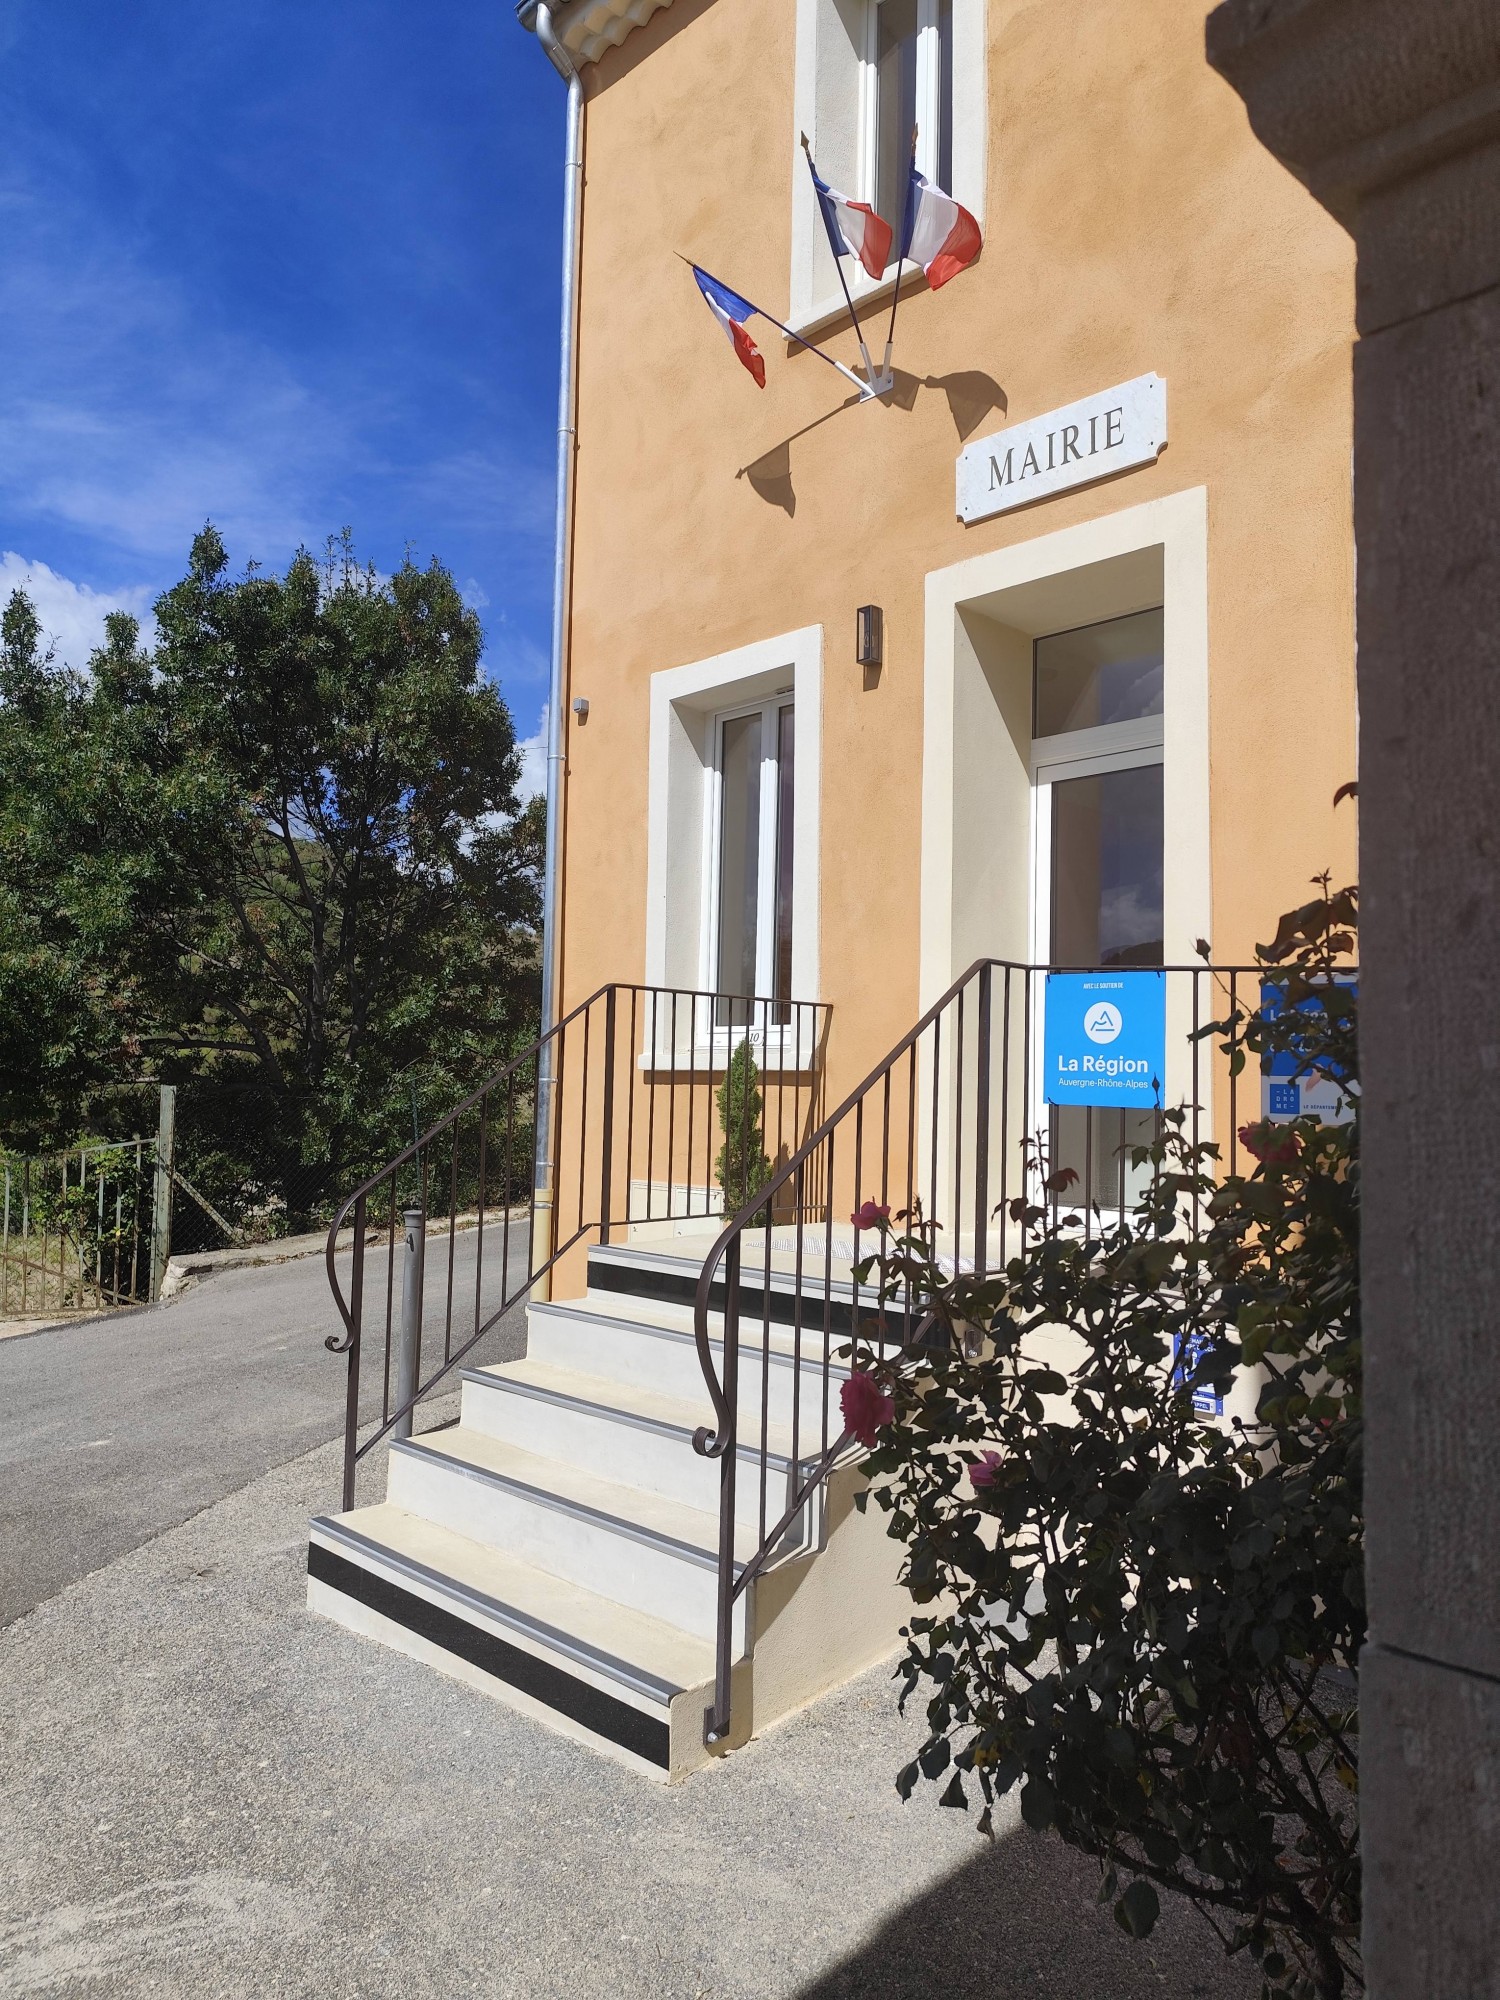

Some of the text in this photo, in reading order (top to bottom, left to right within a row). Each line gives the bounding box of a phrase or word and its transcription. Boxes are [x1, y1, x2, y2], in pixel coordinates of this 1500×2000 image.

[988, 407, 1125, 491] MAIRIE
[1058, 1055, 1148, 1076] La Région
[1059, 1078, 1148, 1089] Auvergne-Rhône-Alpes
